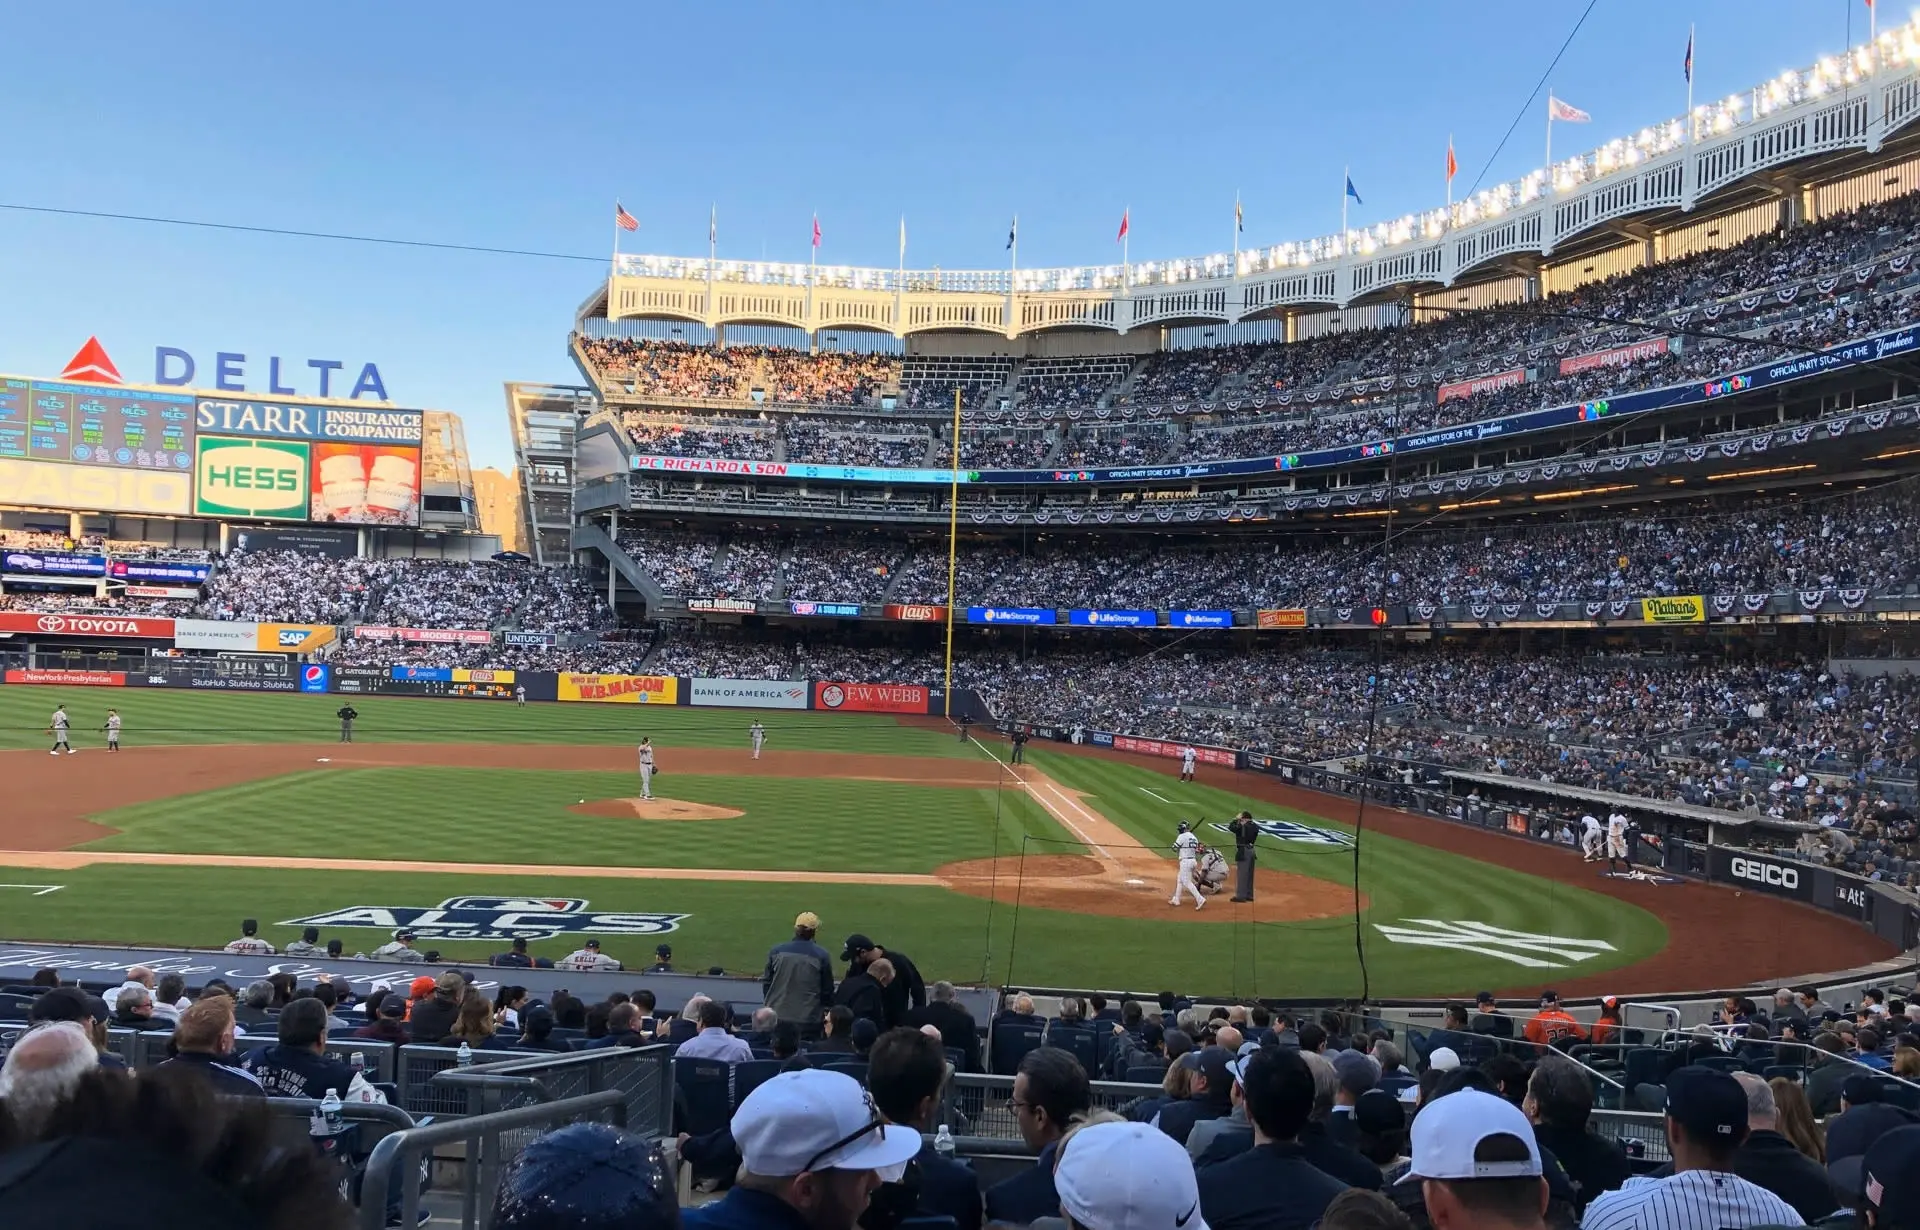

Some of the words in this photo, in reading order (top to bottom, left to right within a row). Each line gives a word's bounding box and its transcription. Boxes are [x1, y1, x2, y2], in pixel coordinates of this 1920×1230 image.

[1601, 350, 1630, 365] PARTY
[1769, 364, 1799, 378] OFFICIAL
[1799, 358, 1818, 371] PARTY
[1819, 352, 1841, 366] STORE
[1842, 350, 1853, 360] OF
[1854, 344, 1869, 356] THE
[1874, 332, 1914, 359] Yankees
[154, 346, 389, 401] DELTA
[196, 401, 312, 435] STARR
[325, 410, 422, 428] INSURANCE
[325, 424, 422, 440] COMPANIES
[1407, 438, 1427, 447] OFFICIAL
[1427, 435, 1440, 444] PARTY
[1440, 432, 1455, 441] STORE
[1456, 430, 1464, 438] OF
[1464, 428, 1473, 437] THE
[1477, 423, 1503, 440] Yankees
[638, 457, 659, 468] PC
[663, 458, 738, 473] RICHARD
[741, 463, 750, 473] &
[755, 464, 788, 475] SON
[1147, 469, 1163, 477] STORE
[209, 465, 297, 491] HESS
[688, 599, 711, 608] Parts
[713, 598, 756, 610] Authority
[1647, 598, 1699, 618] Nathan's
[68, 618, 139, 633] TOYOTA
[279, 631, 306, 645] SAP
[192, 678, 226, 687] StubHub
[228, 679, 260, 688] StubHub
[263, 680, 294, 690] StubHub
[694, 688, 721, 697] BANK
[723, 689, 736, 697] OF
[738, 690, 783, 698] AMERICA
[847, 687, 873, 701] F.W.
[876, 688, 921, 703] WEBB
[1093, 733, 1113, 744] GEICO
[1731, 857, 1799, 889] GEICO
[1847, 887, 1858, 905] At
[316, 908, 671, 933] ALCS
[280, 1068, 308, 1088] TIME
